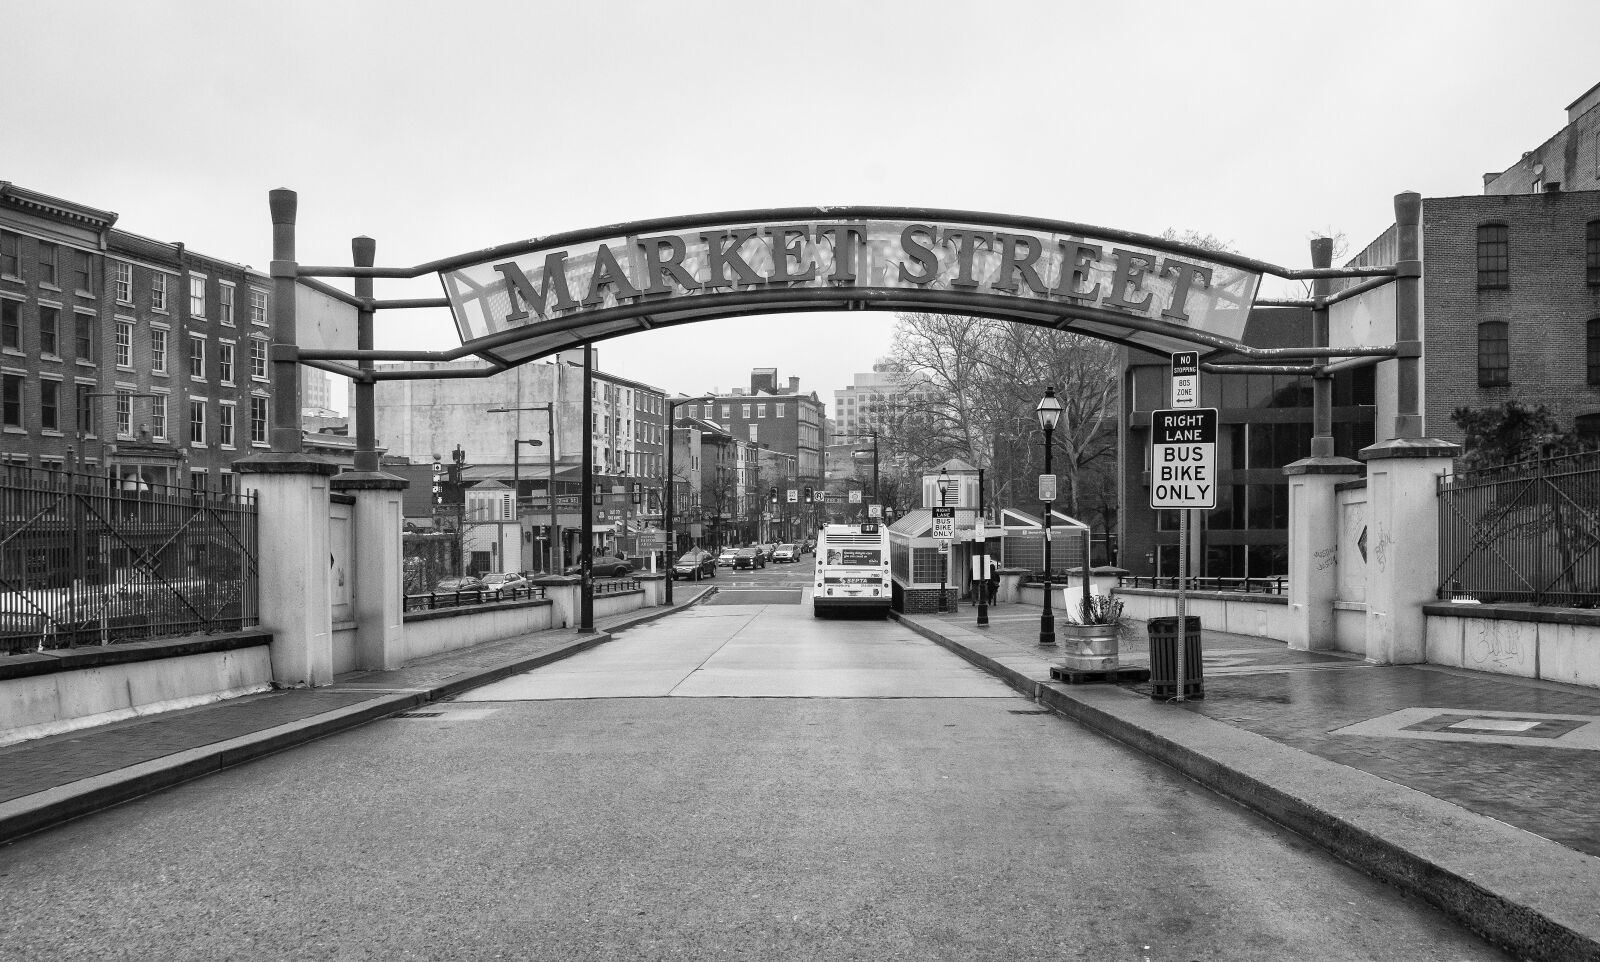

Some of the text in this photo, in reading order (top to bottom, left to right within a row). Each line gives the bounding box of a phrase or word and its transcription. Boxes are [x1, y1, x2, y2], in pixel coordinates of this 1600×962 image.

[493, 224, 1213, 322] MARKET STREET
[1180, 356, 1191, 364] NO
[1178, 379, 1191, 387] BUS
[1177, 388, 1192, 396] ZONE
[1164, 415, 1204, 427] RIGHT
[1165, 429, 1202, 441] LANE
[1164, 446, 1203, 462] BUS
[1161, 465, 1206, 481] BIKE
[1156, 484, 1210, 500] ONLY
